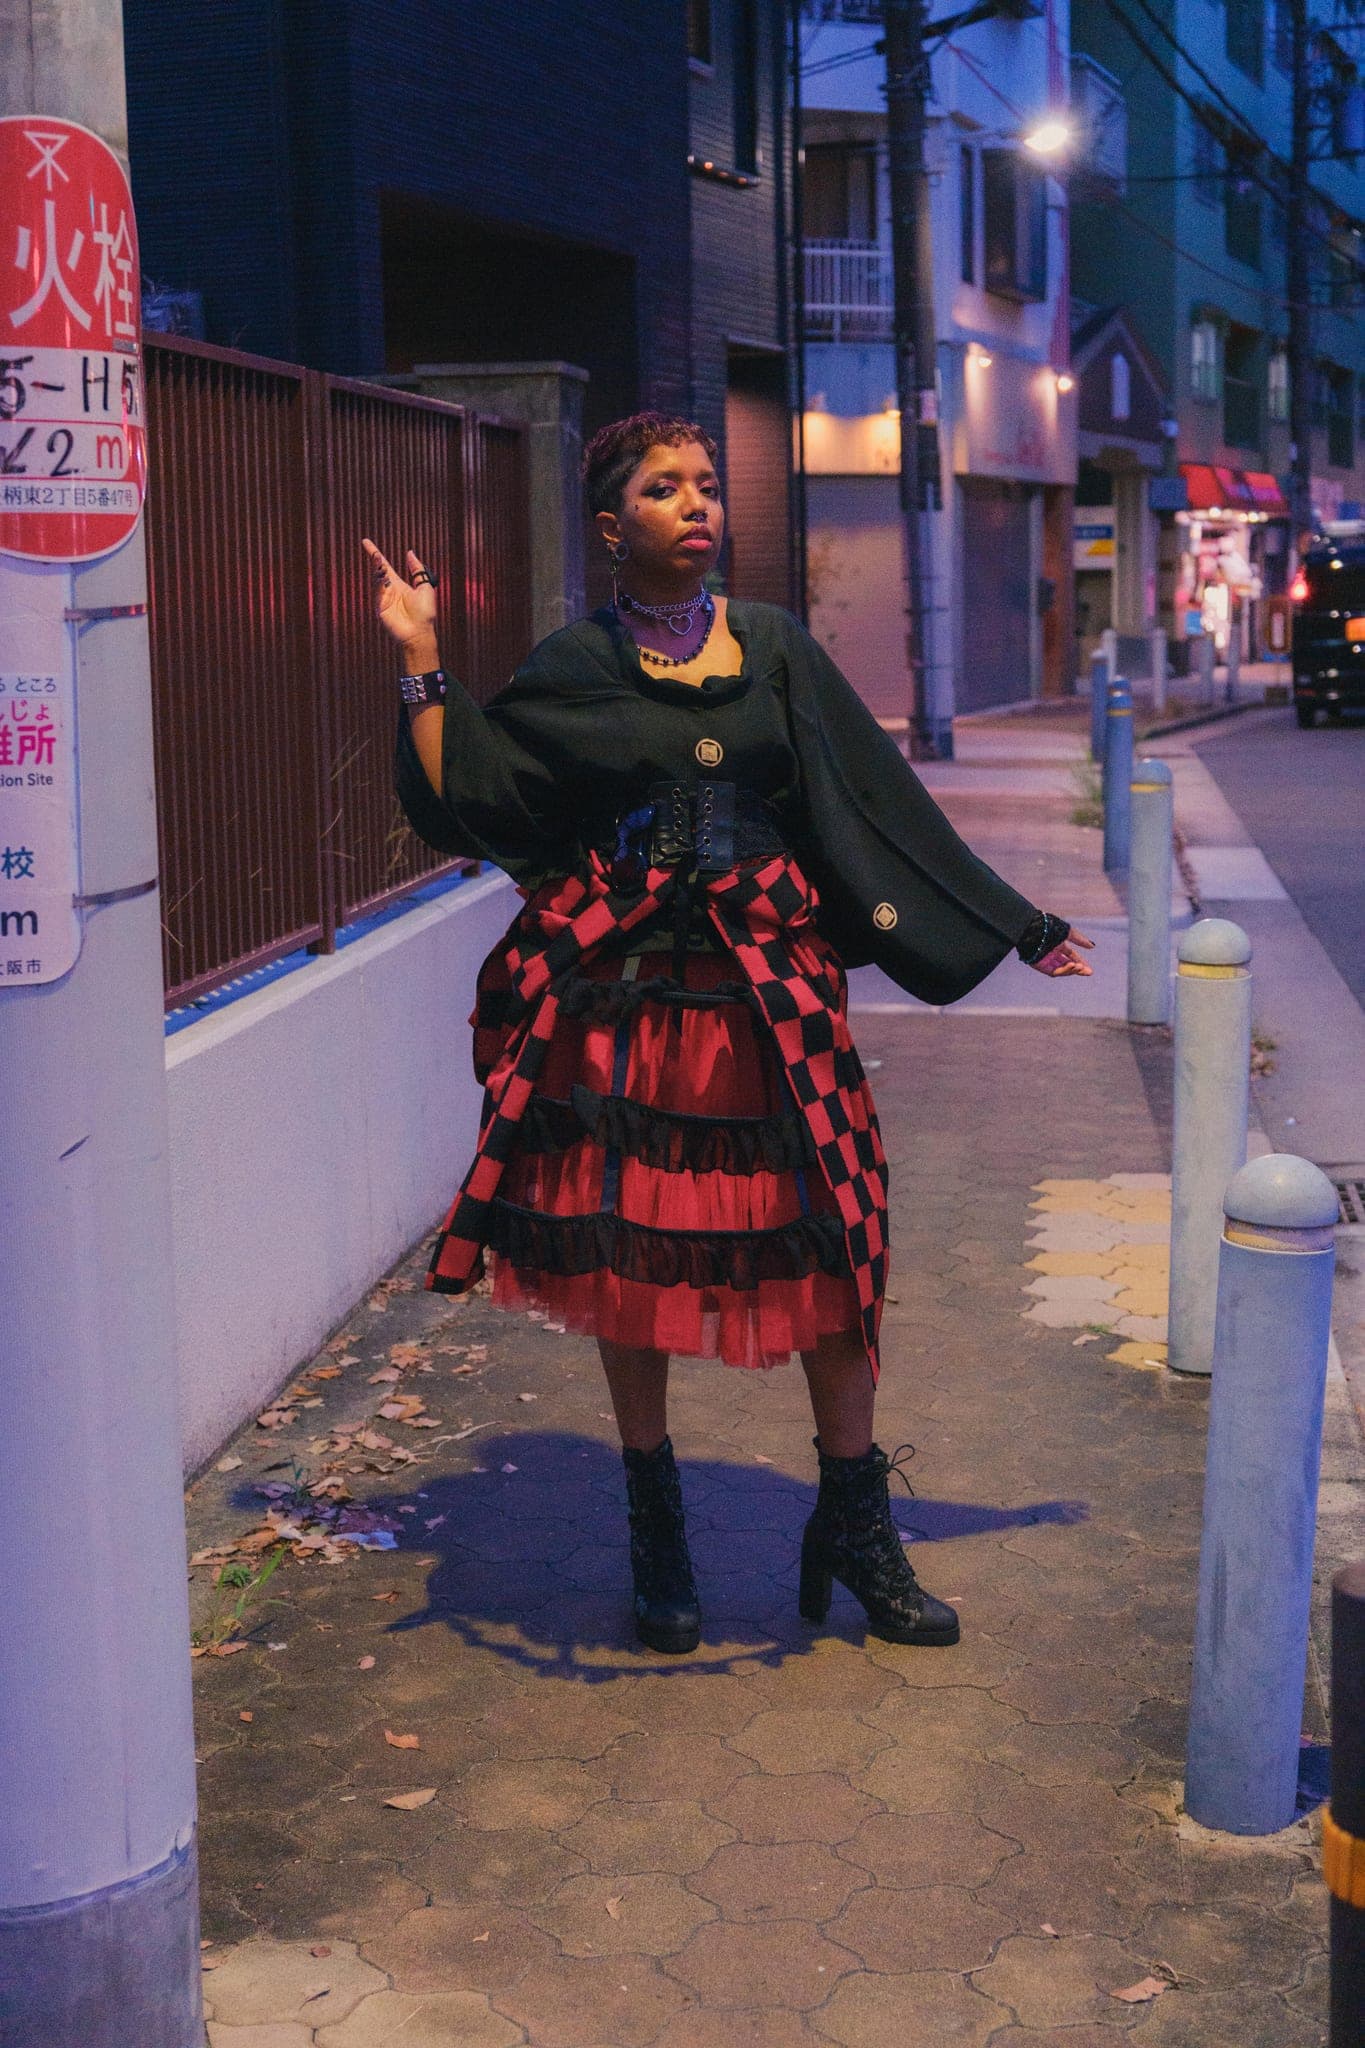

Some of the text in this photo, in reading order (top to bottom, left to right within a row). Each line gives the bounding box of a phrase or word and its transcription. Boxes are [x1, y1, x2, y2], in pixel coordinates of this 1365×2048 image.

[9, 199, 136, 337] 火栓
[96, 434, 123, 469] m
[0, 484, 133, 508] 柄東2丁目5番47号
[15, 678, 56, 693] ところ
[0, 700, 50, 722] じょ
[27, 772, 54, 786] Site
[1, 846, 35, 880] 校
[0, 910, 38, 937] m
